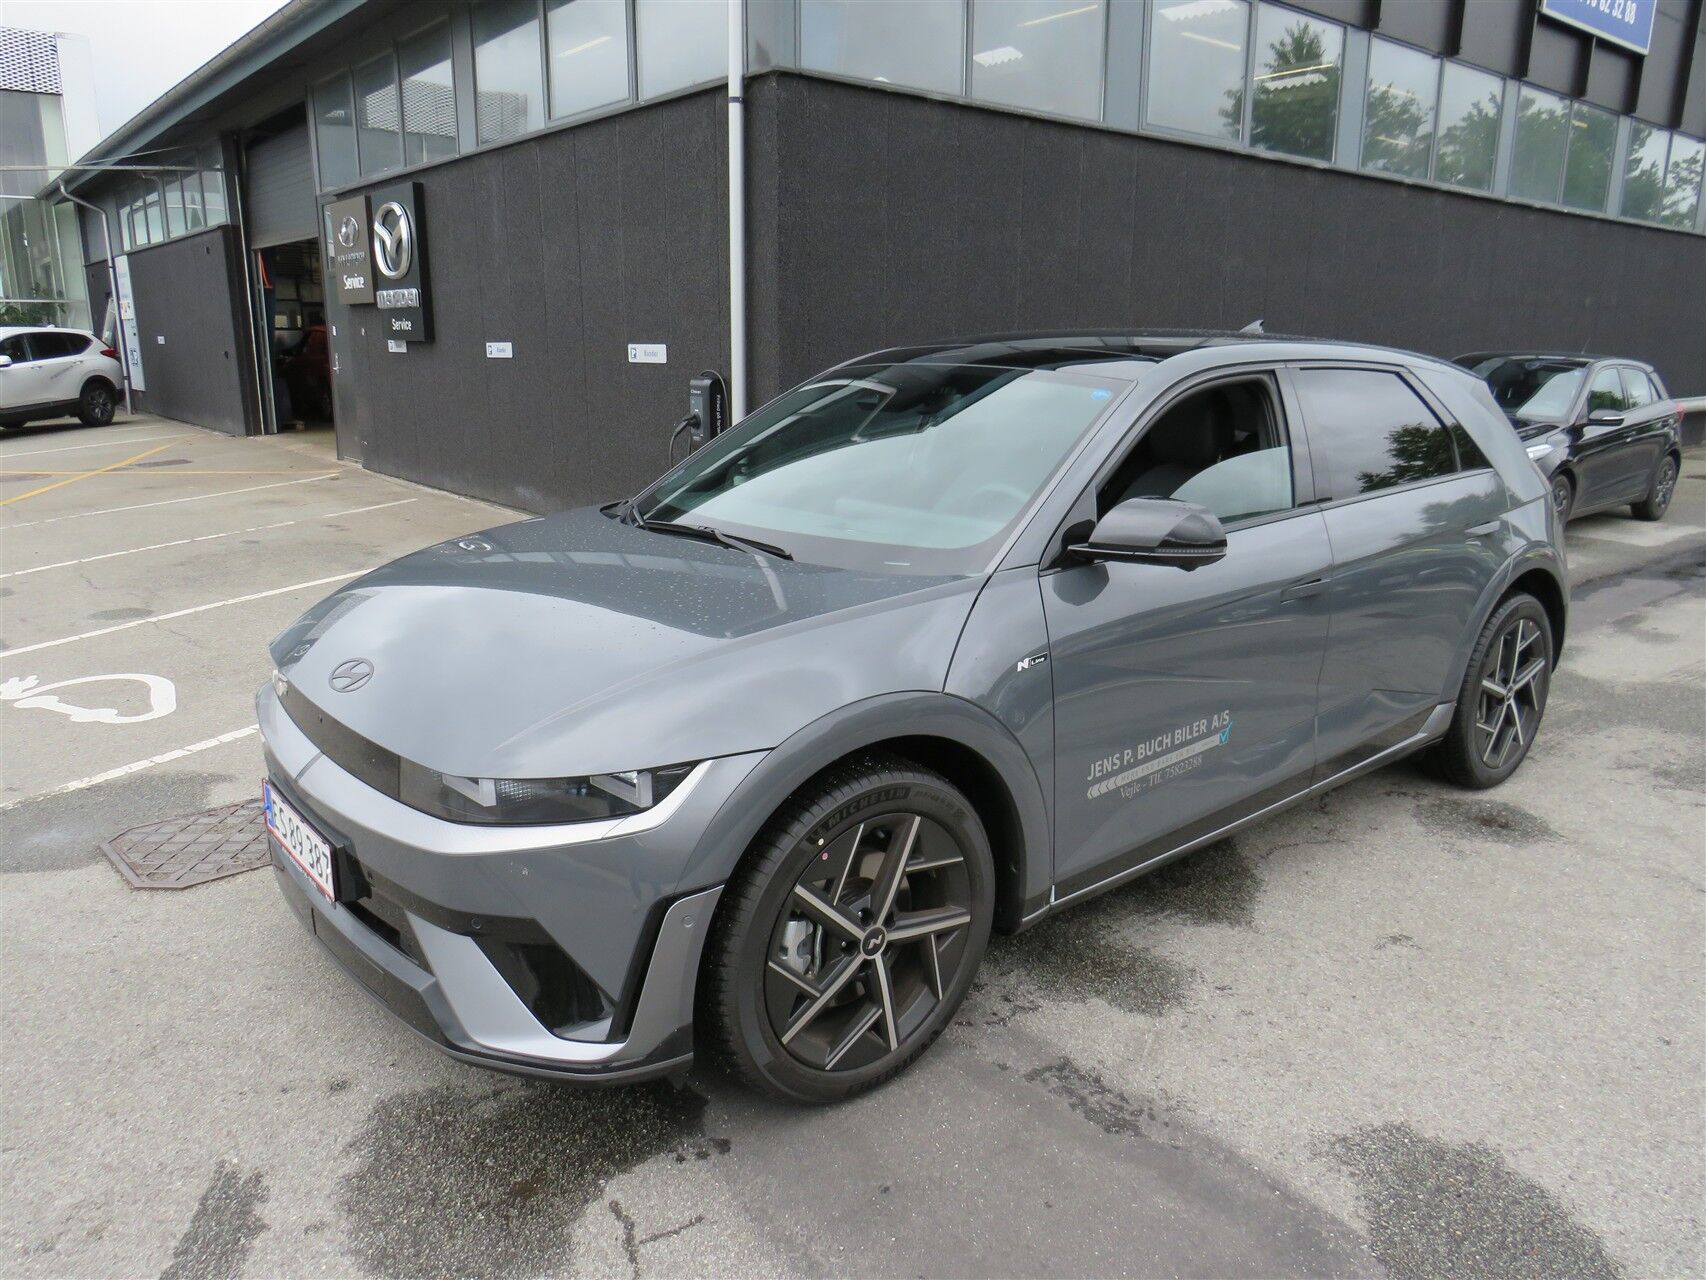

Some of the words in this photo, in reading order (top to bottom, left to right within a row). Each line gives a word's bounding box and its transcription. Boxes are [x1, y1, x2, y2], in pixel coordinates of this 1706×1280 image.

[1624, 0, 1637, 25] 88
[343, 274, 365, 290] Service
[391, 318, 412, 331] Service
[1087, 753, 1120, 780] JENS
[1123, 749, 1134, 766] P.
[1137, 733, 1171, 760] BUCH
[1174, 719, 1207, 746] BILER
[1211, 709, 1230, 730] A/S
[1120, 781, 1141, 799] Vejle
[272, 799, 287, 839] ES
[289, 817, 303, 857] 89
[306, 834, 330, 885] 387
